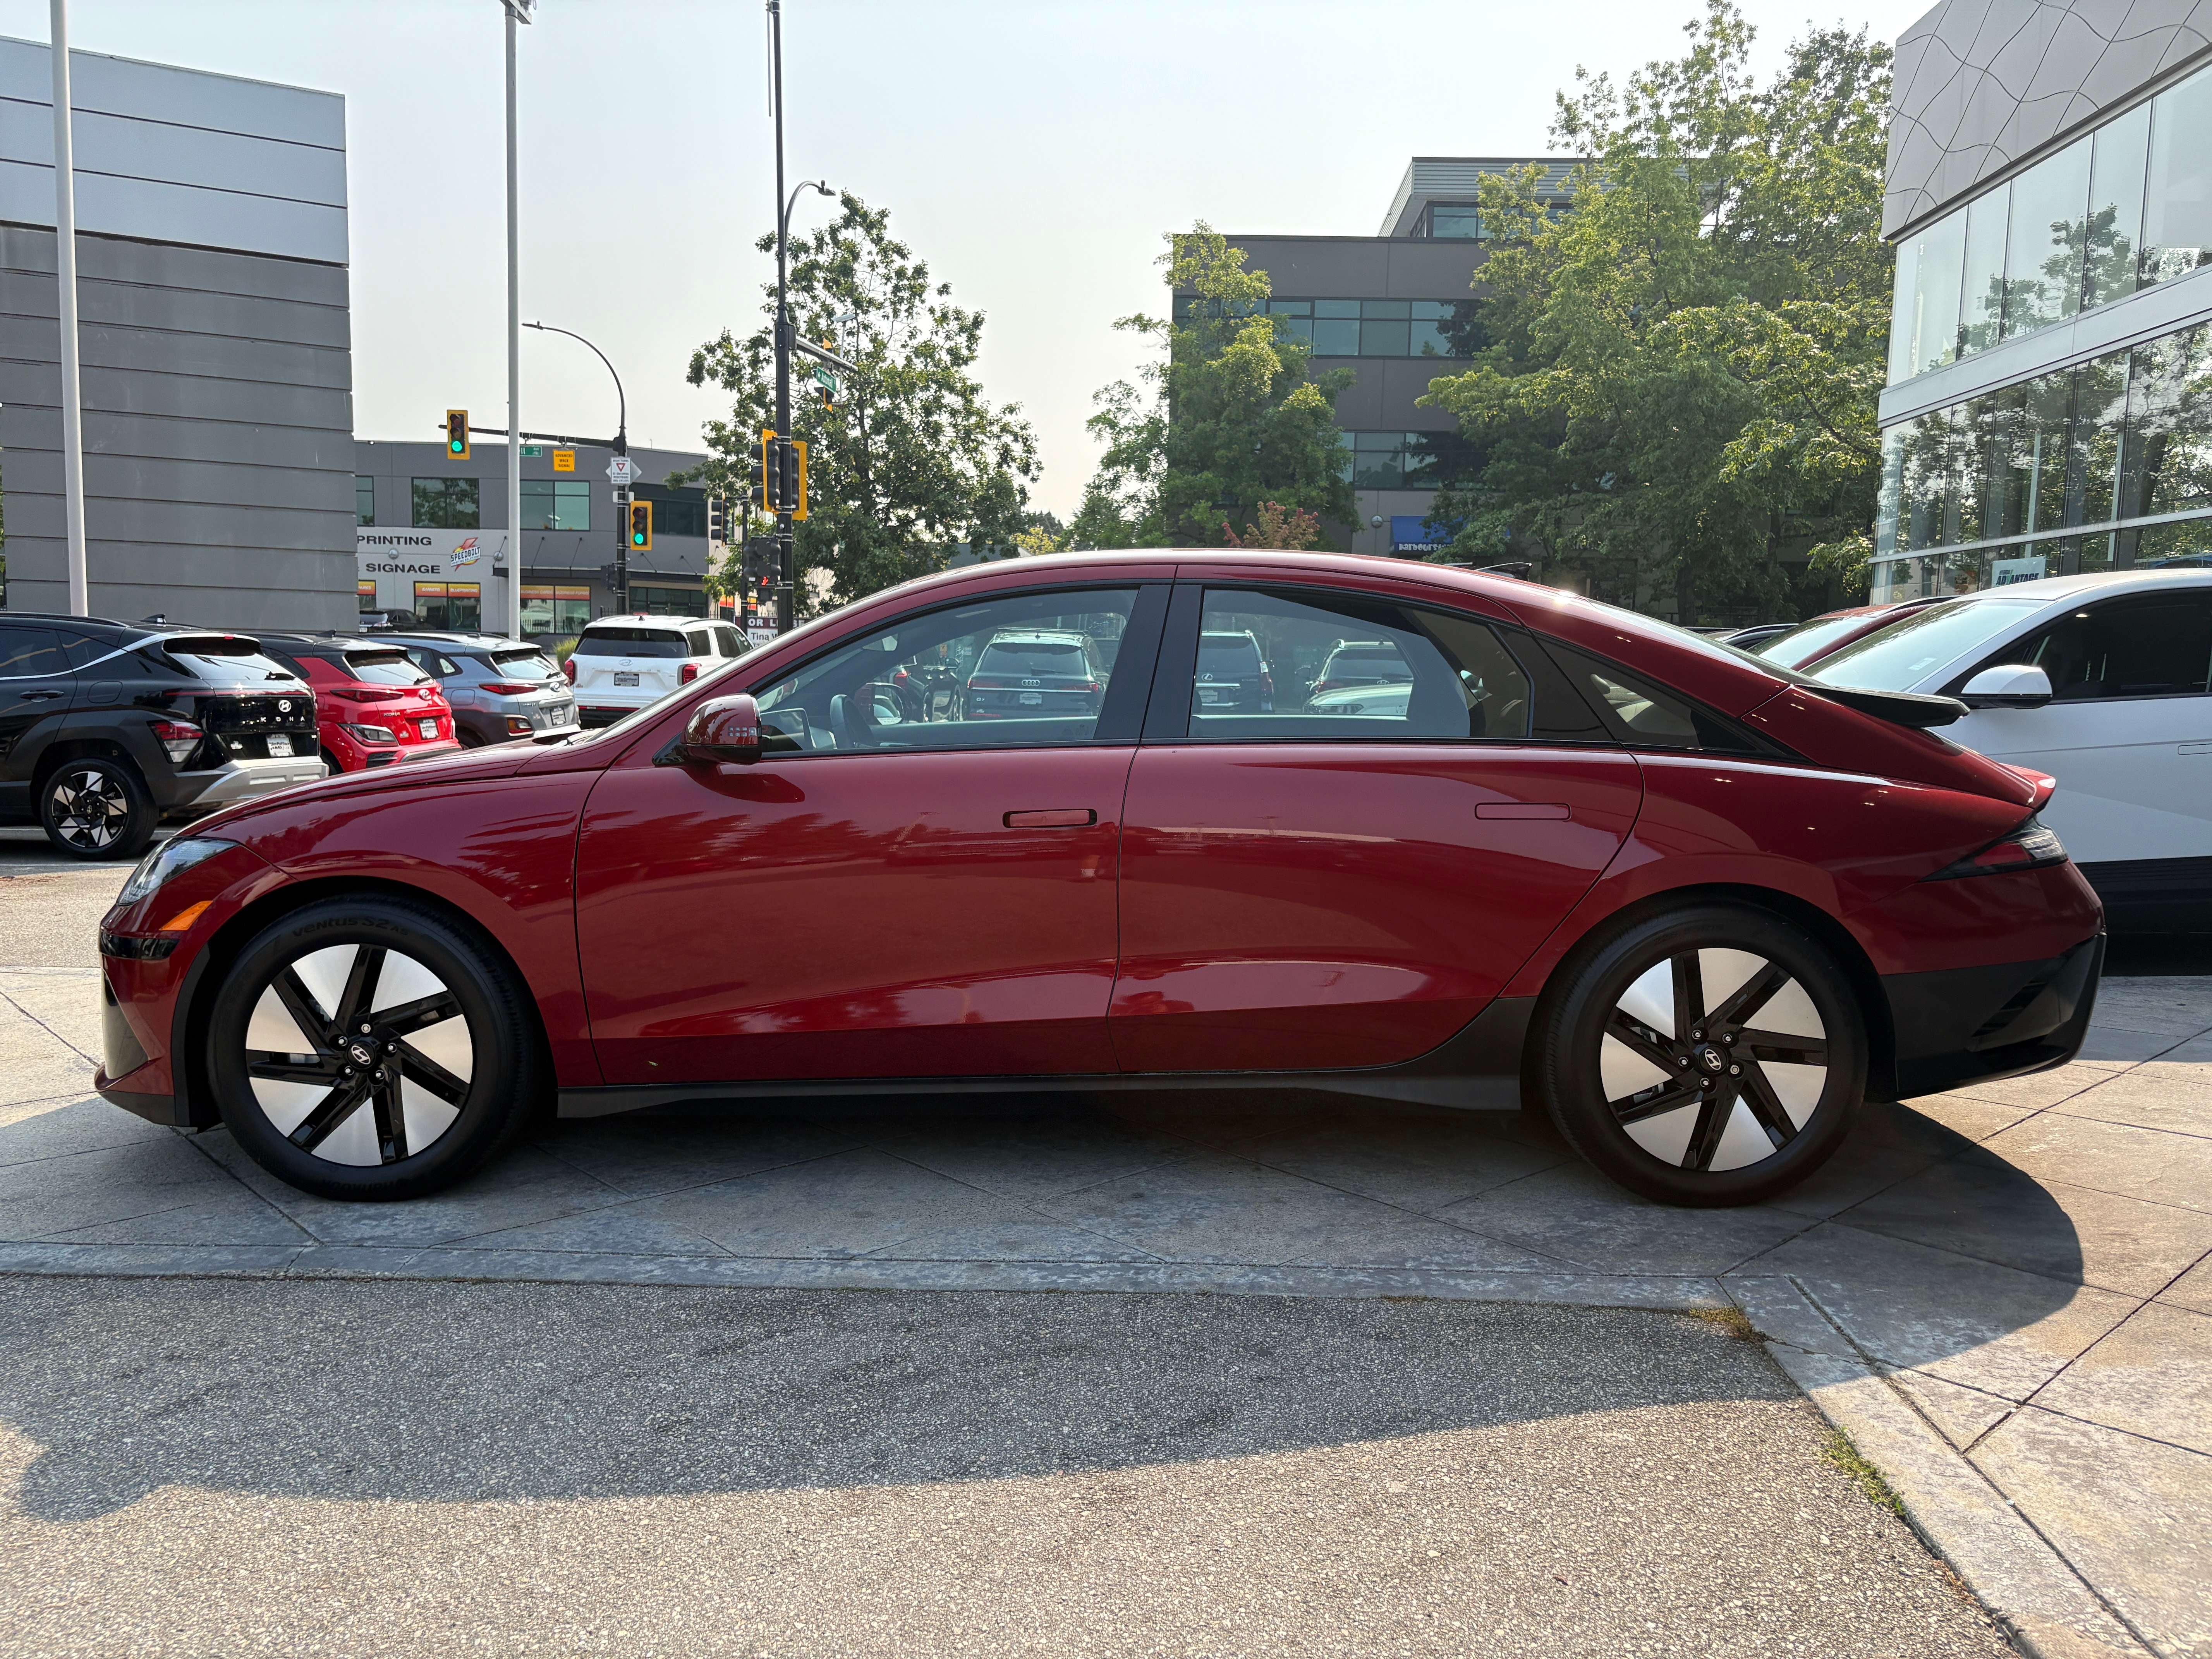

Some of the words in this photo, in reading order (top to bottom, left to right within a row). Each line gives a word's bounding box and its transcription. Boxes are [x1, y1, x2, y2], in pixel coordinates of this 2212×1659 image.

[357, 535, 432, 546] PRINTING
[451, 546, 480, 562] SPEEDBOLT
[366, 563, 440, 574] SIGNAGE
[1996, 572, 2039, 586] ADVANTAGE
[748, 618, 763, 627] OR
[750, 632, 769, 641] Tina
